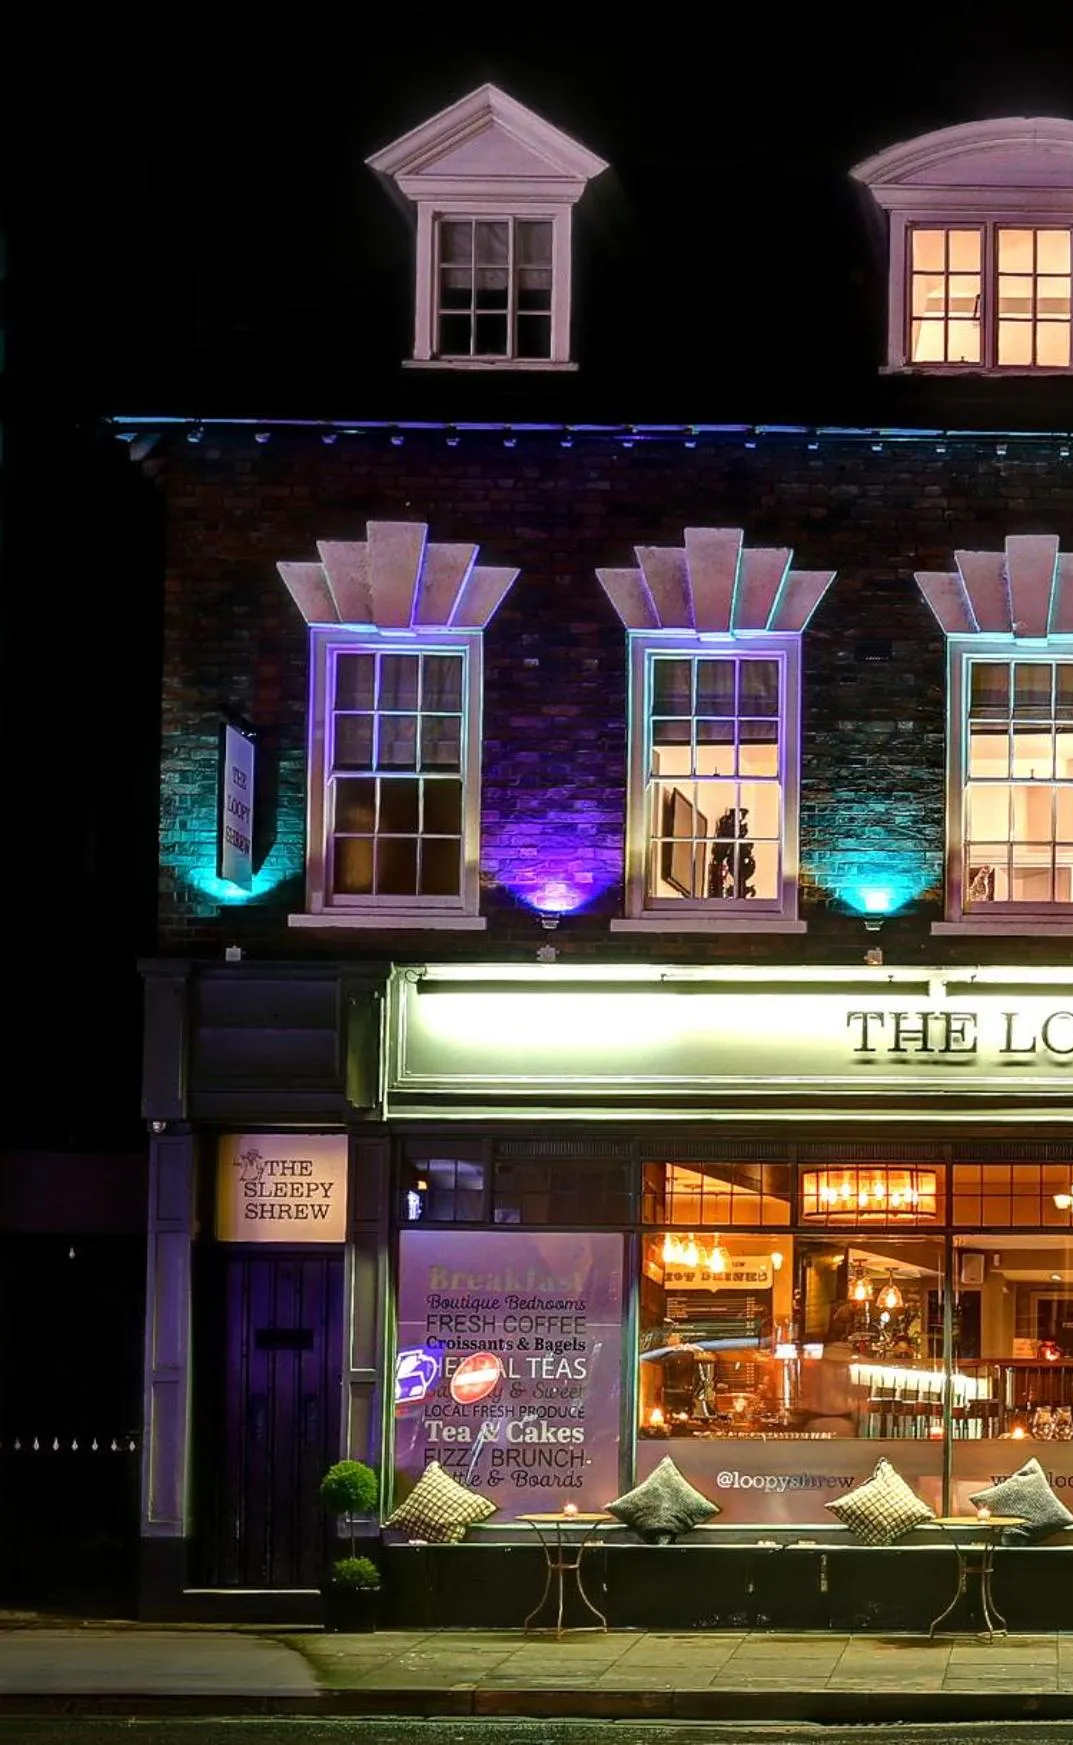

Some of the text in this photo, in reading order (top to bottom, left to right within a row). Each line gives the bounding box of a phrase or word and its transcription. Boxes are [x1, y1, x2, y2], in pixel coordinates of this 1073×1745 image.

[846, 1011, 978, 1054] THE
[264, 1160, 313, 1177] THE
[243, 1181, 334, 1199] SLEEPY
[244, 1202, 331, 1220] SHREW
[426, 1294, 586, 1312] Boutique Bedrooms
[426, 1315, 586, 1334] FRESH COFFEE
[426, 1336, 586, 1354] Croissants & Bagels
[526, 1358, 587, 1379] TEAS
[510, 1382, 526, 1398] &
[424, 1405, 585, 1418] LOCAL FRESH PRODUCE
[425, 1420, 585, 1443] Tea & Cakes
[492, 1449, 584, 1467] BRUNCH
[487, 1471, 504, 1487] &
[510, 1470, 583, 1488] Boards
[716, 1471, 854, 1493] @loopyshrew
